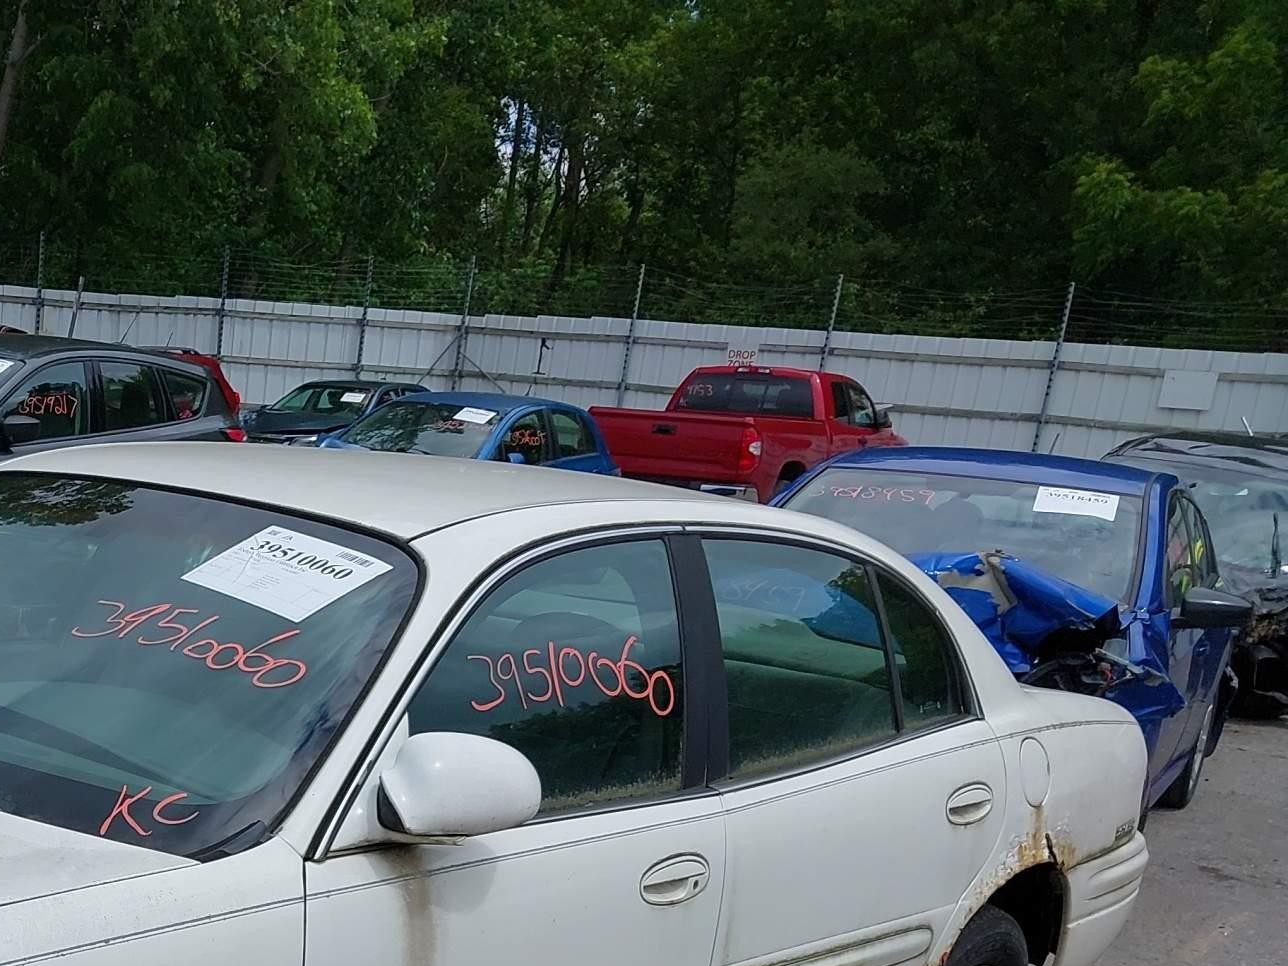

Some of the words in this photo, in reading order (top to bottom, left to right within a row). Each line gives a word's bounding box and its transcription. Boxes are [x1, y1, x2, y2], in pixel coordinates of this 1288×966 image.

[728, 349, 756, 360] DROP
[249, 539, 354, 580] 39510060
[71, 599, 307, 689] 39510060
[467, 634, 675, 717] 39510060
